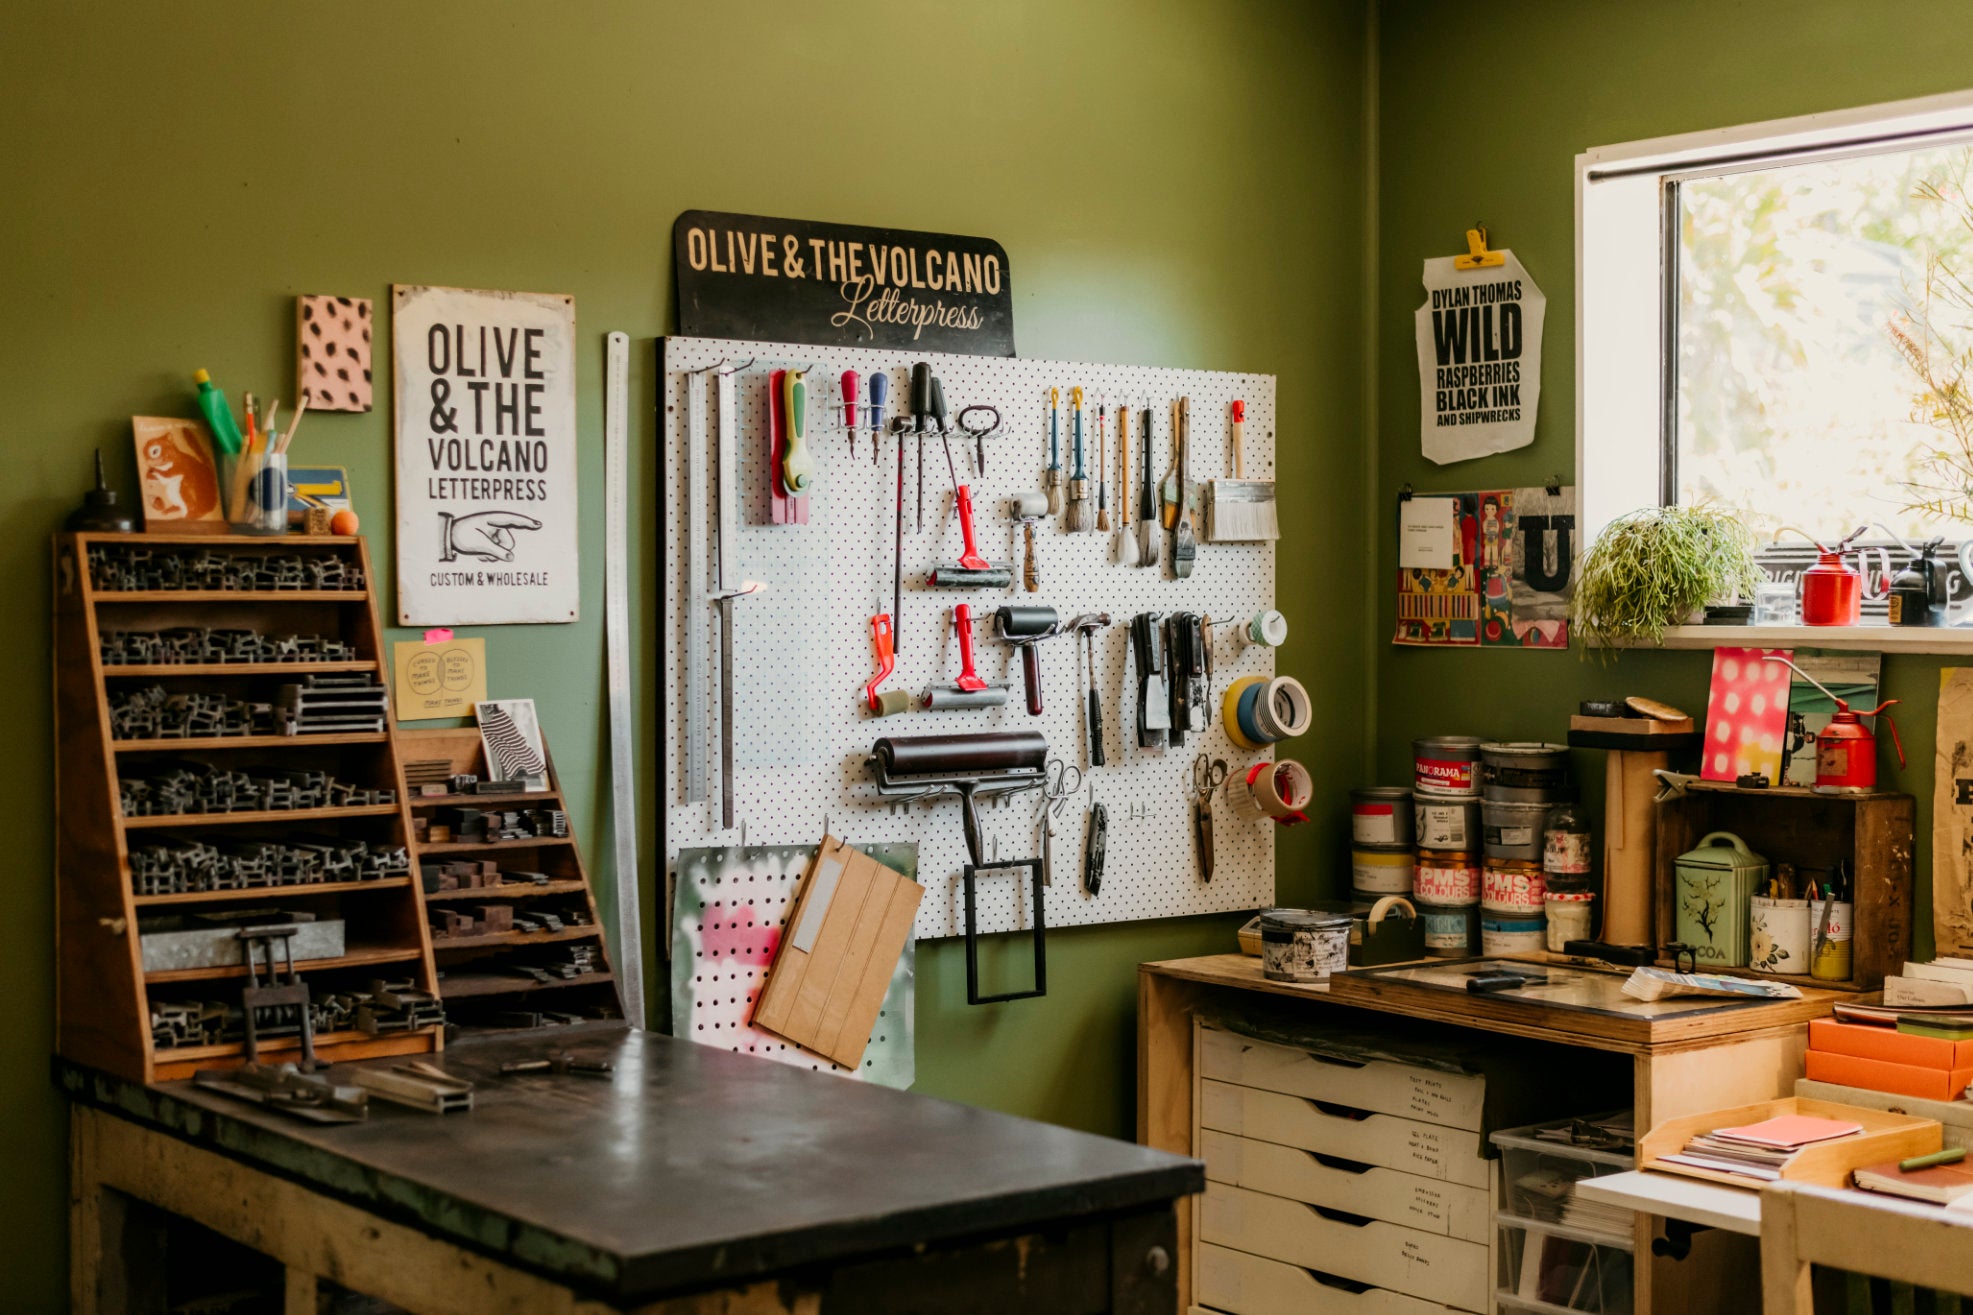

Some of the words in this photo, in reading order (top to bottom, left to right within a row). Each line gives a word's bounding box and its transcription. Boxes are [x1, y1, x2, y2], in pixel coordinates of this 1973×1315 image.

[687, 227, 779, 277] OLIVE
[783, 234, 806, 279] &
[808, 238, 866, 284] THE
[868, 243, 1001, 296] VOLCANO
[830, 274, 984, 341] Letterpress
[1432, 286, 1470, 310] DYLAN
[1472, 279, 1522, 305] THOMAS
[1432, 302, 1522, 366] WILD
[428, 323, 545, 380] OLIVE
[1436, 360, 1520, 389] RASPBERRIES
[429, 377, 459, 434] &
[467, 381, 545, 437] THE
[1436, 387, 1489, 412] BLACK
[1492, 383, 1520, 408] INK
[1436, 413, 1457, 427] AND
[1458, 408, 1521, 426] SHIPWRECKS
[428, 438, 548, 473] VOLCANO
[428, 477, 547, 501] LETTERPRESS
[1518, 515, 1575, 592] U
[430, 572, 474, 587] CUSTOM
[477, 571, 485, 586] &
[486, 572, 549, 586] WHOLESALE
[1416, 762, 1460, 778] PANORAMA
[1420, 867, 1470, 887] PMS
[1420, 885, 1470, 898] COLOURS
[1485, 872, 1529, 893] PMS
